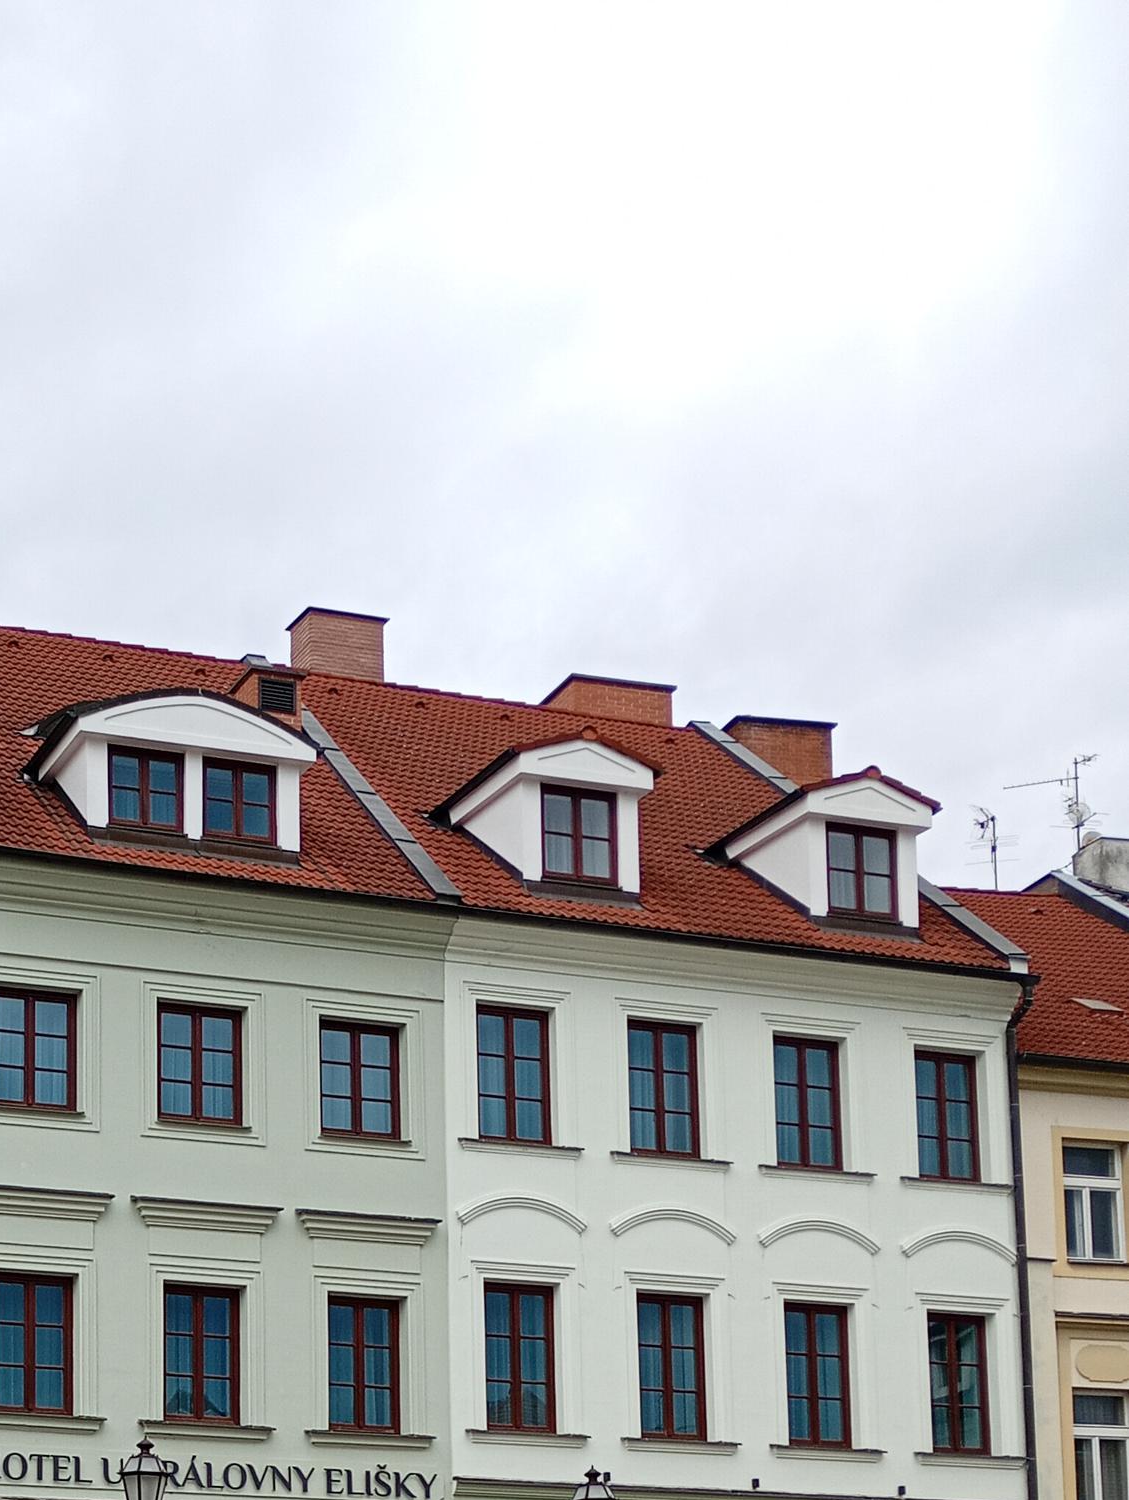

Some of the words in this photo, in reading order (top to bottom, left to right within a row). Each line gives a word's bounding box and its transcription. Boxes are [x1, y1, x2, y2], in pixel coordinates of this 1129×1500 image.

[101, 1457, 124, 1485] U
[160, 1455, 315, 1493] RÁLOVNY
[324, 1464, 437, 1499] ELIŠKY
